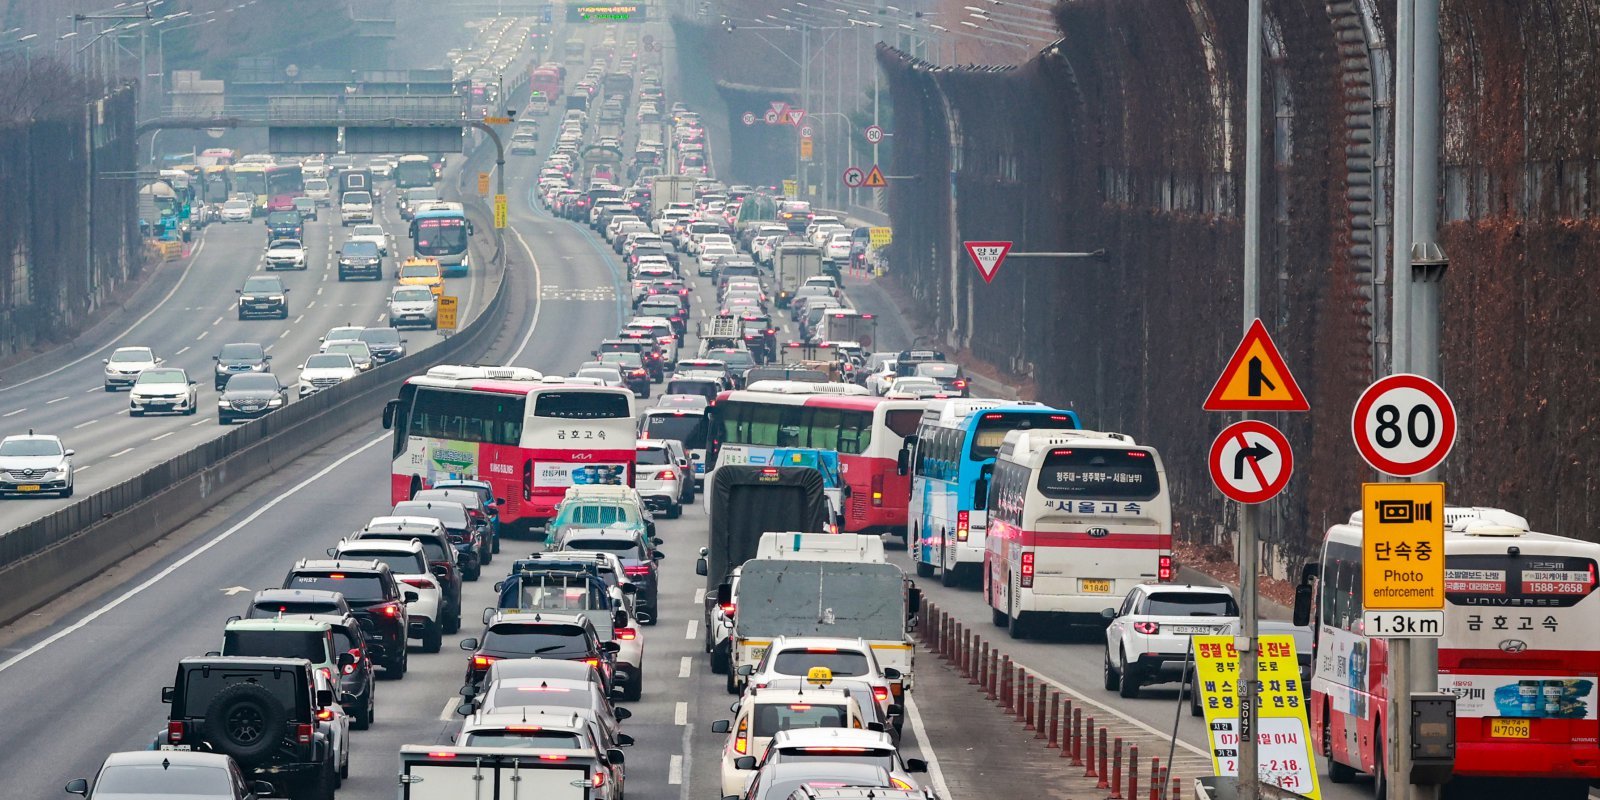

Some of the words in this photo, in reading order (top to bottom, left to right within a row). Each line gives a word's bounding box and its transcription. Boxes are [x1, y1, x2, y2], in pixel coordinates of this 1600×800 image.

[869, 130, 879, 139] 80
[1375, 404, 1436, 448] 80
[557, 430, 606, 440] 금호고속
[1056, 501, 1140, 515] 서울고속
[1090, 528, 1106, 536] KIA
[1375, 541, 1432, 561] 단속중
[1384, 570, 1424, 582] Photo
[1373, 586, 1434, 597] enforcement
[1530, 583, 1583, 593] 1588-2658
[1467, 598, 1560, 606] UNIVERSE
[1374, 615, 1438, 633] 1.3km
[1467, 615, 1558, 632] 금호고속
[1199, 643, 1222, 658] 명절
[1267, 642, 1291, 657] 전날
[1273, 696, 1298, 708] 연장
[1275, 733, 1297, 744] 01시
